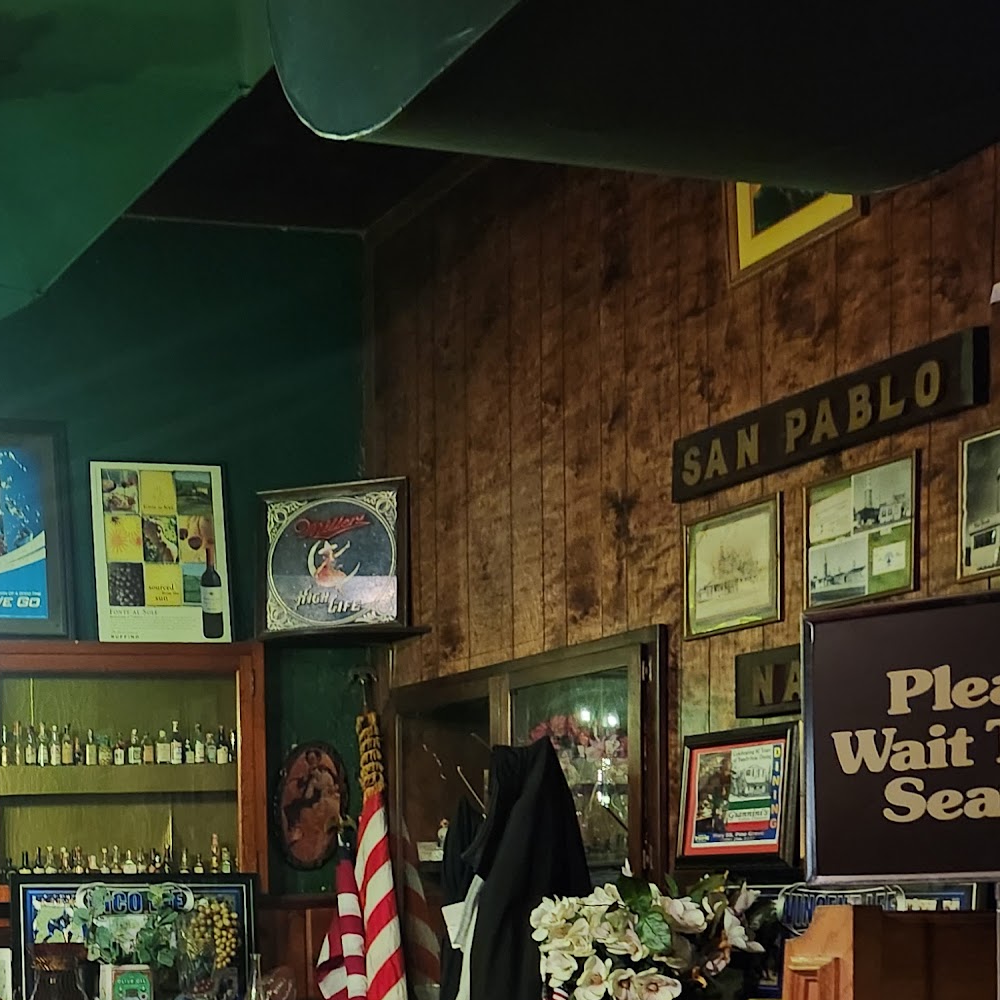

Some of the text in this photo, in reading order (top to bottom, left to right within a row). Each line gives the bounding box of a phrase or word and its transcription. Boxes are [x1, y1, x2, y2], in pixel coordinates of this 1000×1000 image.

[681, 359, 941, 486] SAN PABLO
[17, 596, 41, 608] GO
[886, 664, 1000, 715] Ple
[830, 724, 975, 775] Wait
[769, 747, 781, 828] DINING
[882, 776, 1000, 823] Sea
